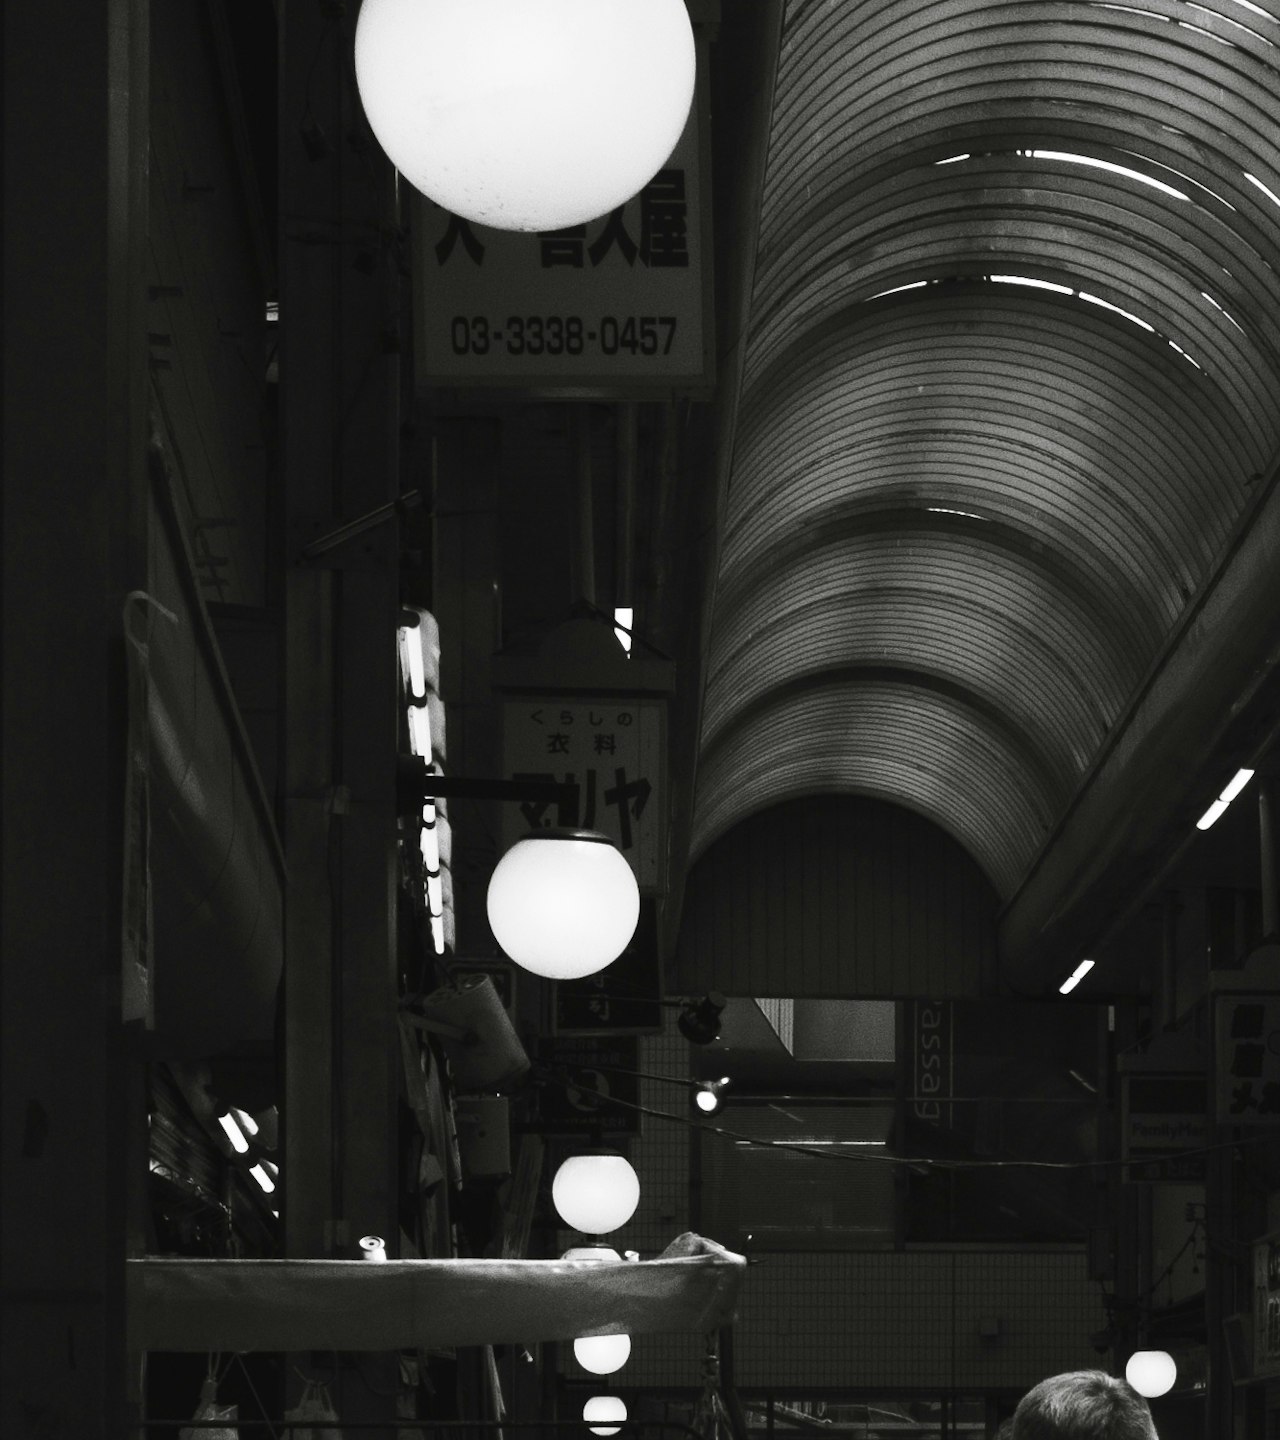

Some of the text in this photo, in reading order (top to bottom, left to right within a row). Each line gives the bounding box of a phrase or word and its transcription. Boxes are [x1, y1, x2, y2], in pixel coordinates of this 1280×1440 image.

[451, 315, 677, 356] 03-3338-0457
[530, 708, 633, 727] くらしの
[546, 732, 617, 755] 衣料
[1131, 1122, 1206, 1140] FamilyMar
